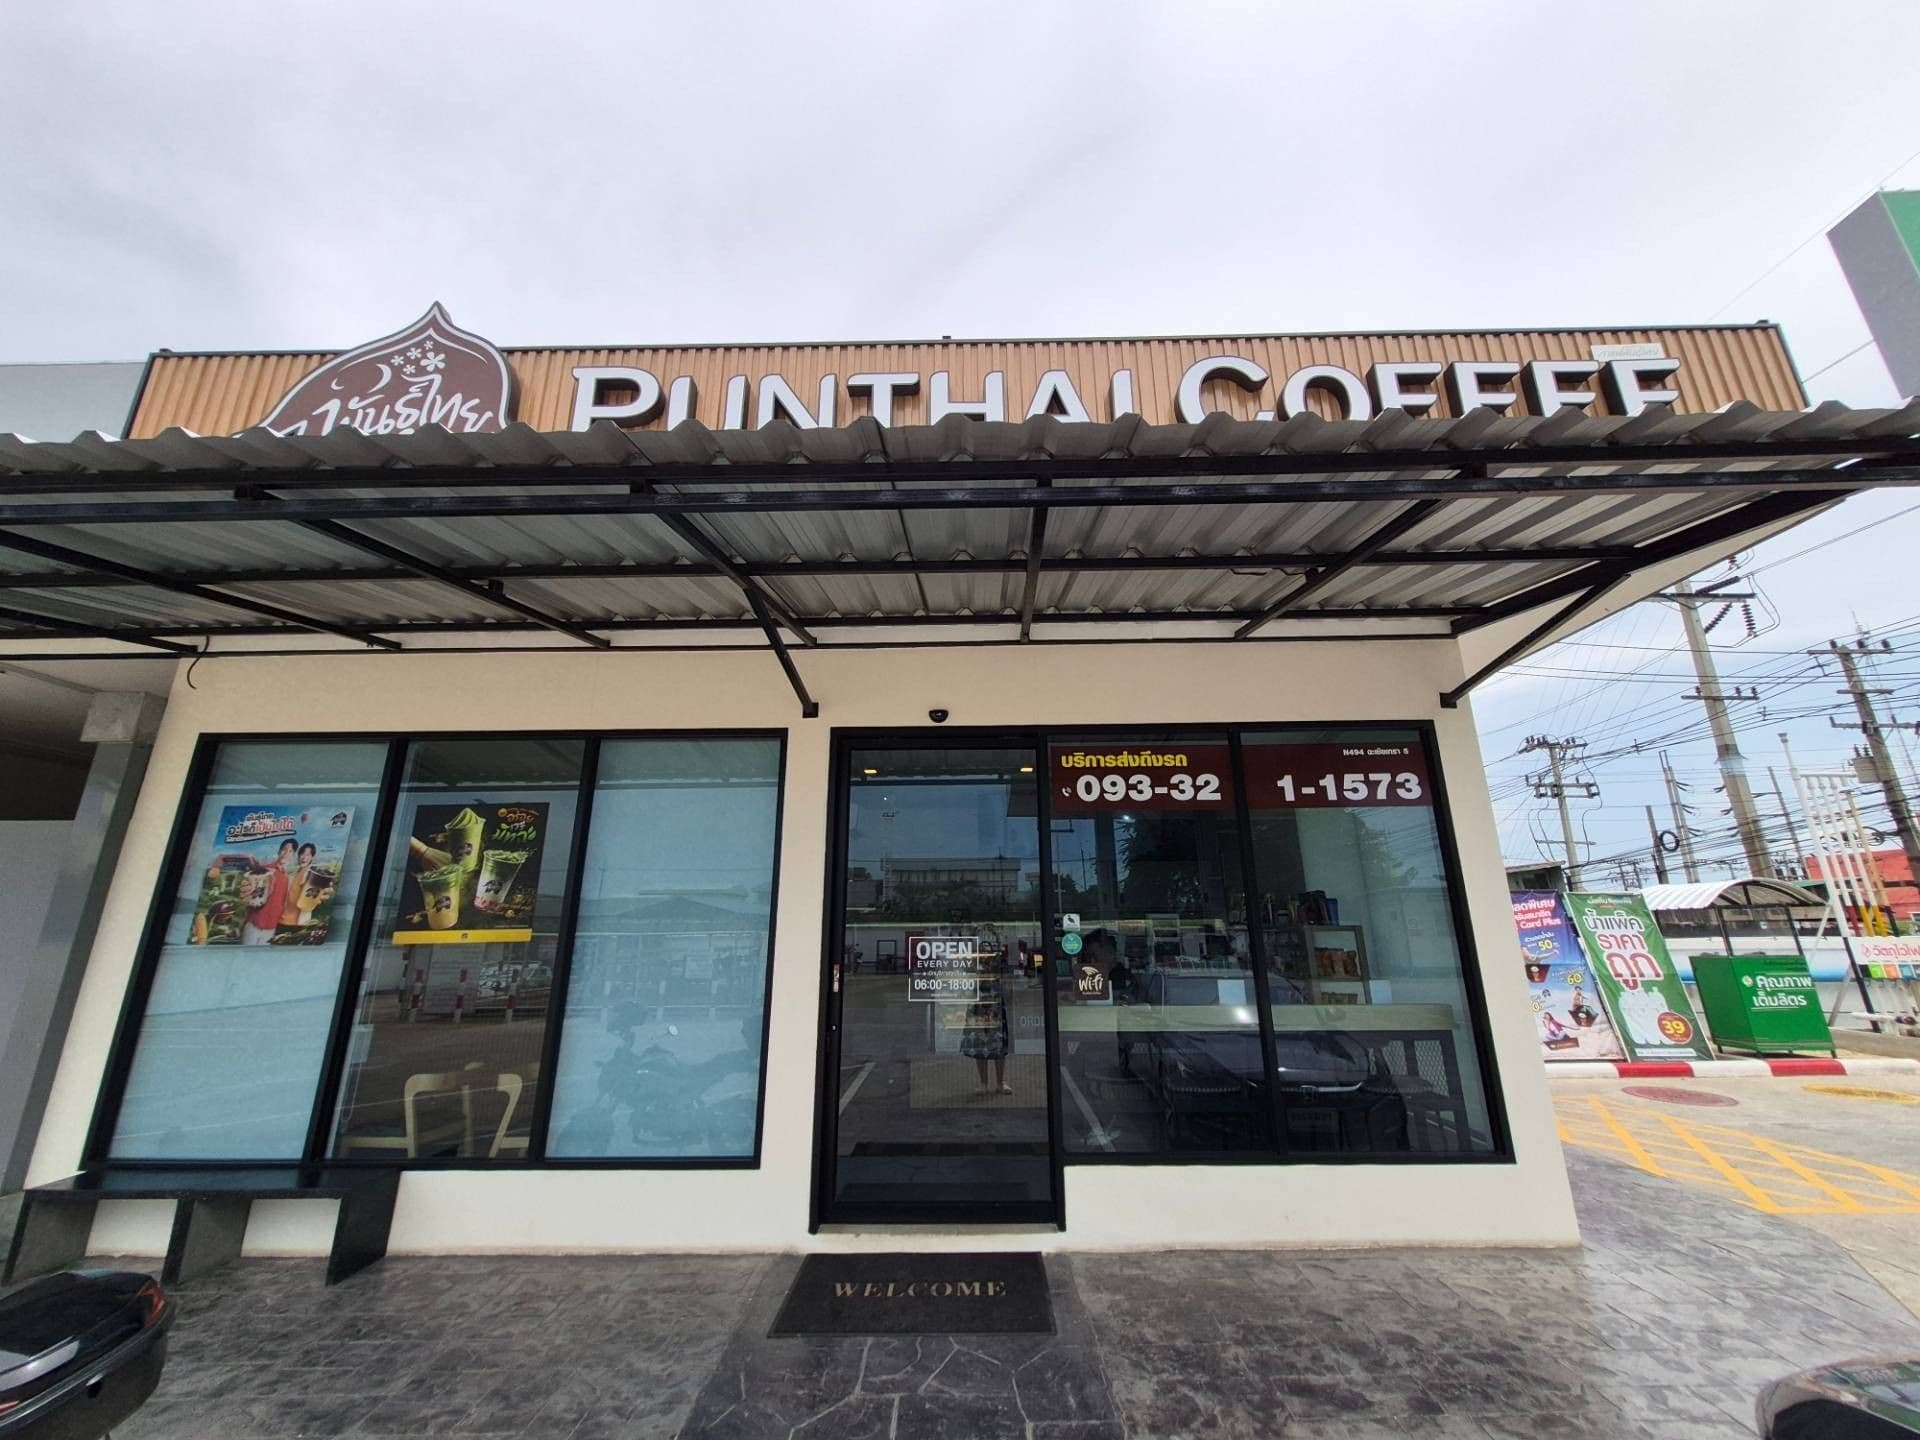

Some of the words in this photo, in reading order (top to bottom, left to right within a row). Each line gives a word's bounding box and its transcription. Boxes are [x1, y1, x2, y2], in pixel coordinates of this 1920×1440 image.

[1076, 773, 1222, 802] 093-32
[1276, 772, 1422, 801] 1-1573
[916, 941, 972, 959] OPEN
[1596, 933, 1647, 950] ราคา
[917, 960, 949, 968] EVERY
[953, 960, 973, 968] DAY
[1605, 952, 1663, 990] ถูก
[1755, 975, 1812, 992] คุณภาพ
[1752, 991, 1807, 1007] เต็มลิตร
[1661, 1020, 1686, 1035] 39
[834, 1280, 1007, 1298] WELCOME
